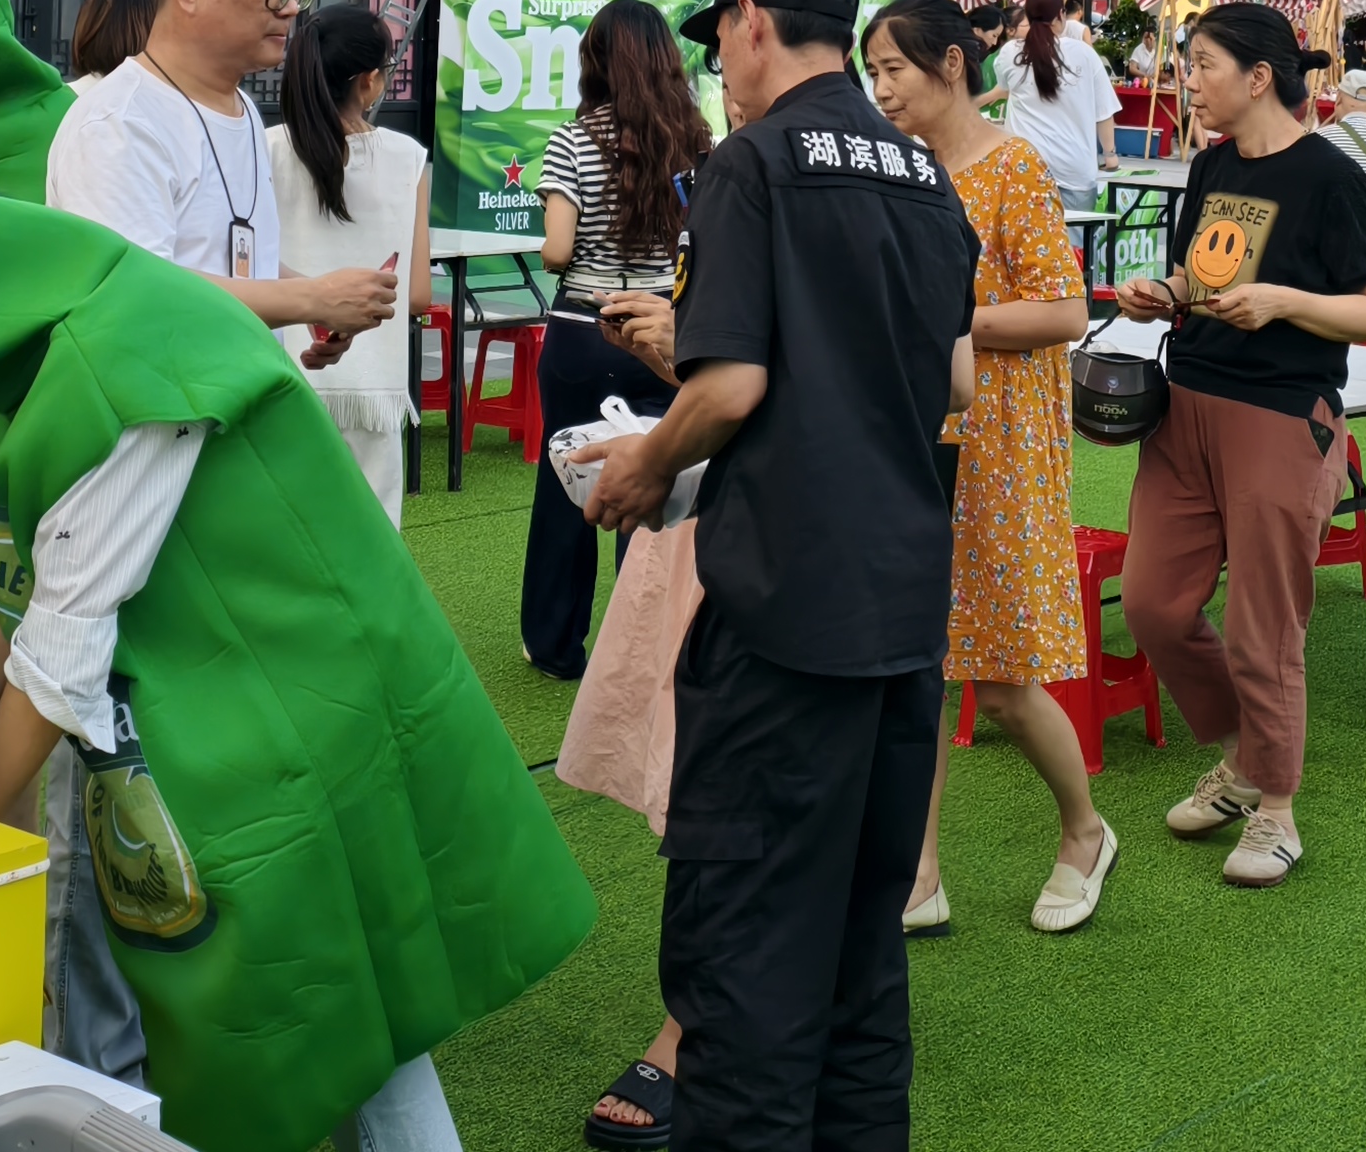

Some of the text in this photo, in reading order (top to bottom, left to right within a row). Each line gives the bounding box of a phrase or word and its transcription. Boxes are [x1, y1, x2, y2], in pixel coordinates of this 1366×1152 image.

[801, 131, 938, 185] 湖滨服务
[494, 211, 530, 231] SILVER
[1212, 199, 1235, 217] CAN
[1236, 202, 1269, 226] SEE
